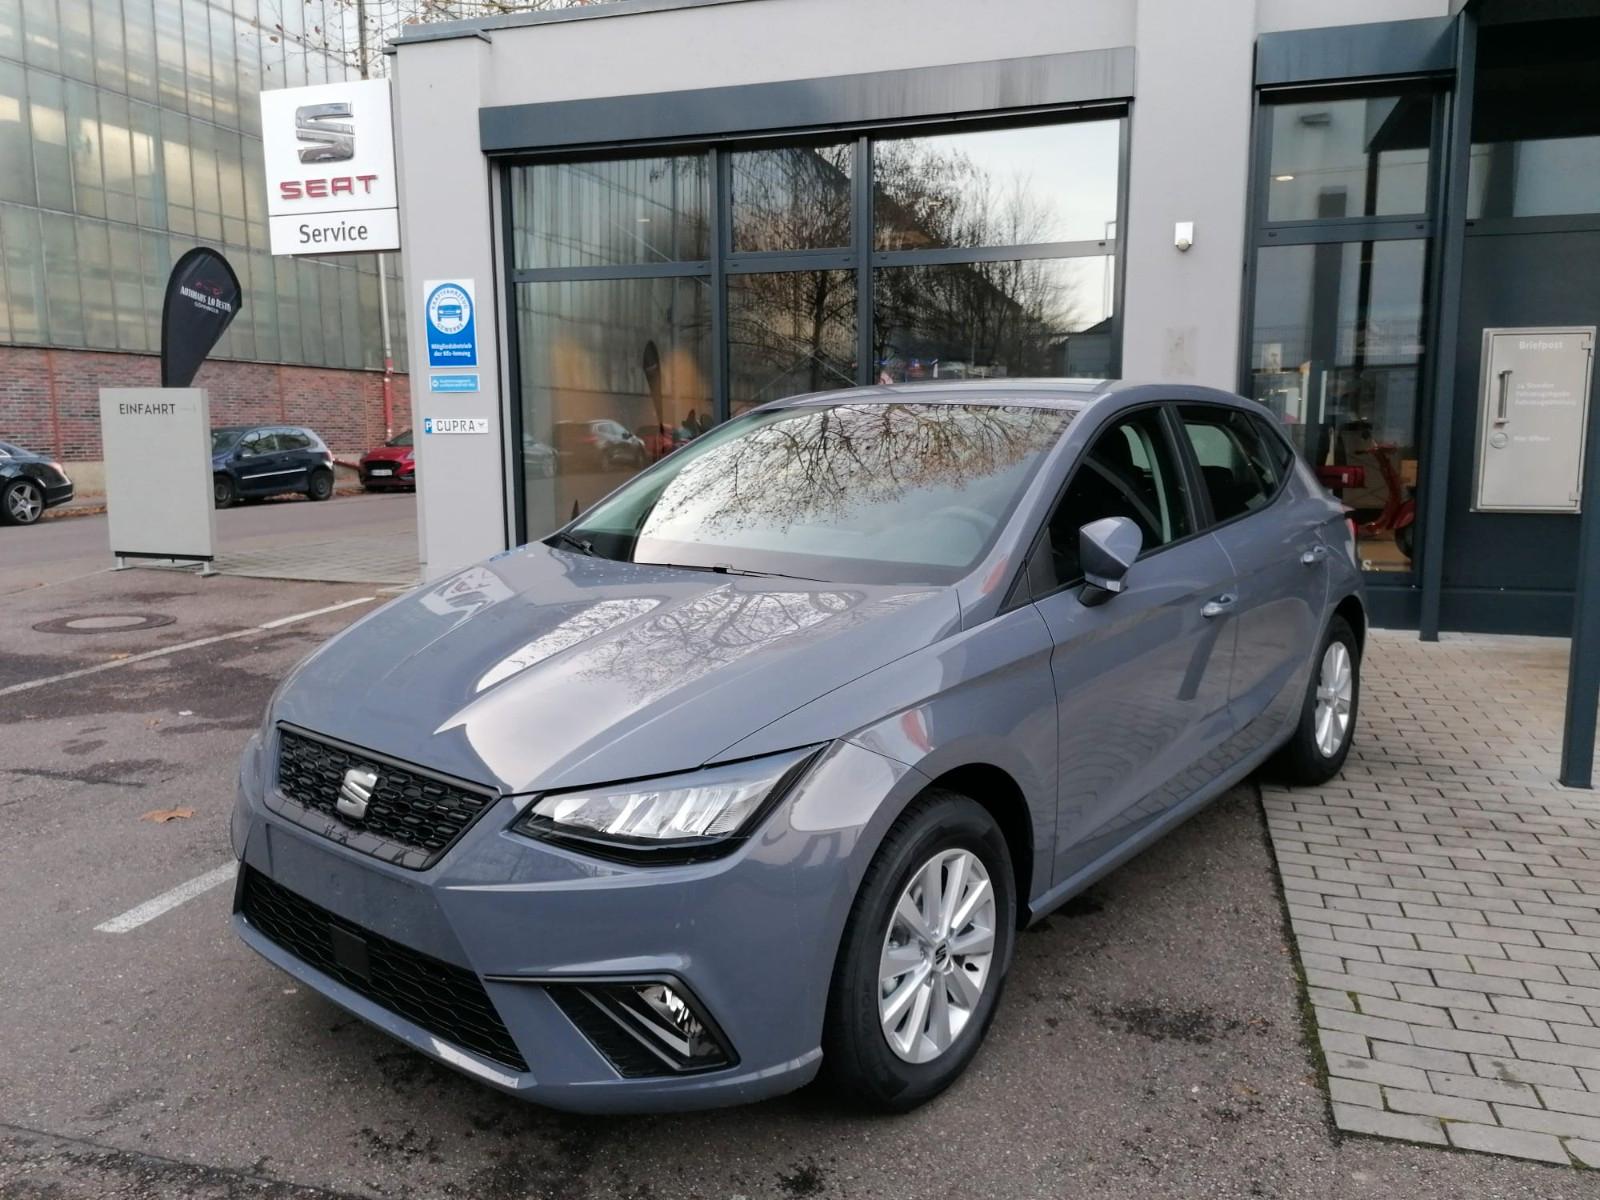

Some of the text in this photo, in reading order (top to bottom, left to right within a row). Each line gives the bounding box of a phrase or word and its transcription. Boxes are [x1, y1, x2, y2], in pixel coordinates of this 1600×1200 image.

[280, 175, 378, 200] SEAT
[299, 220, 369, 244] Service
[1519, 339, 1563, 352] Briefpost
[119, 403, 176, 415] EINFAHRT
[436, 420, 475, 432] CUPRA
